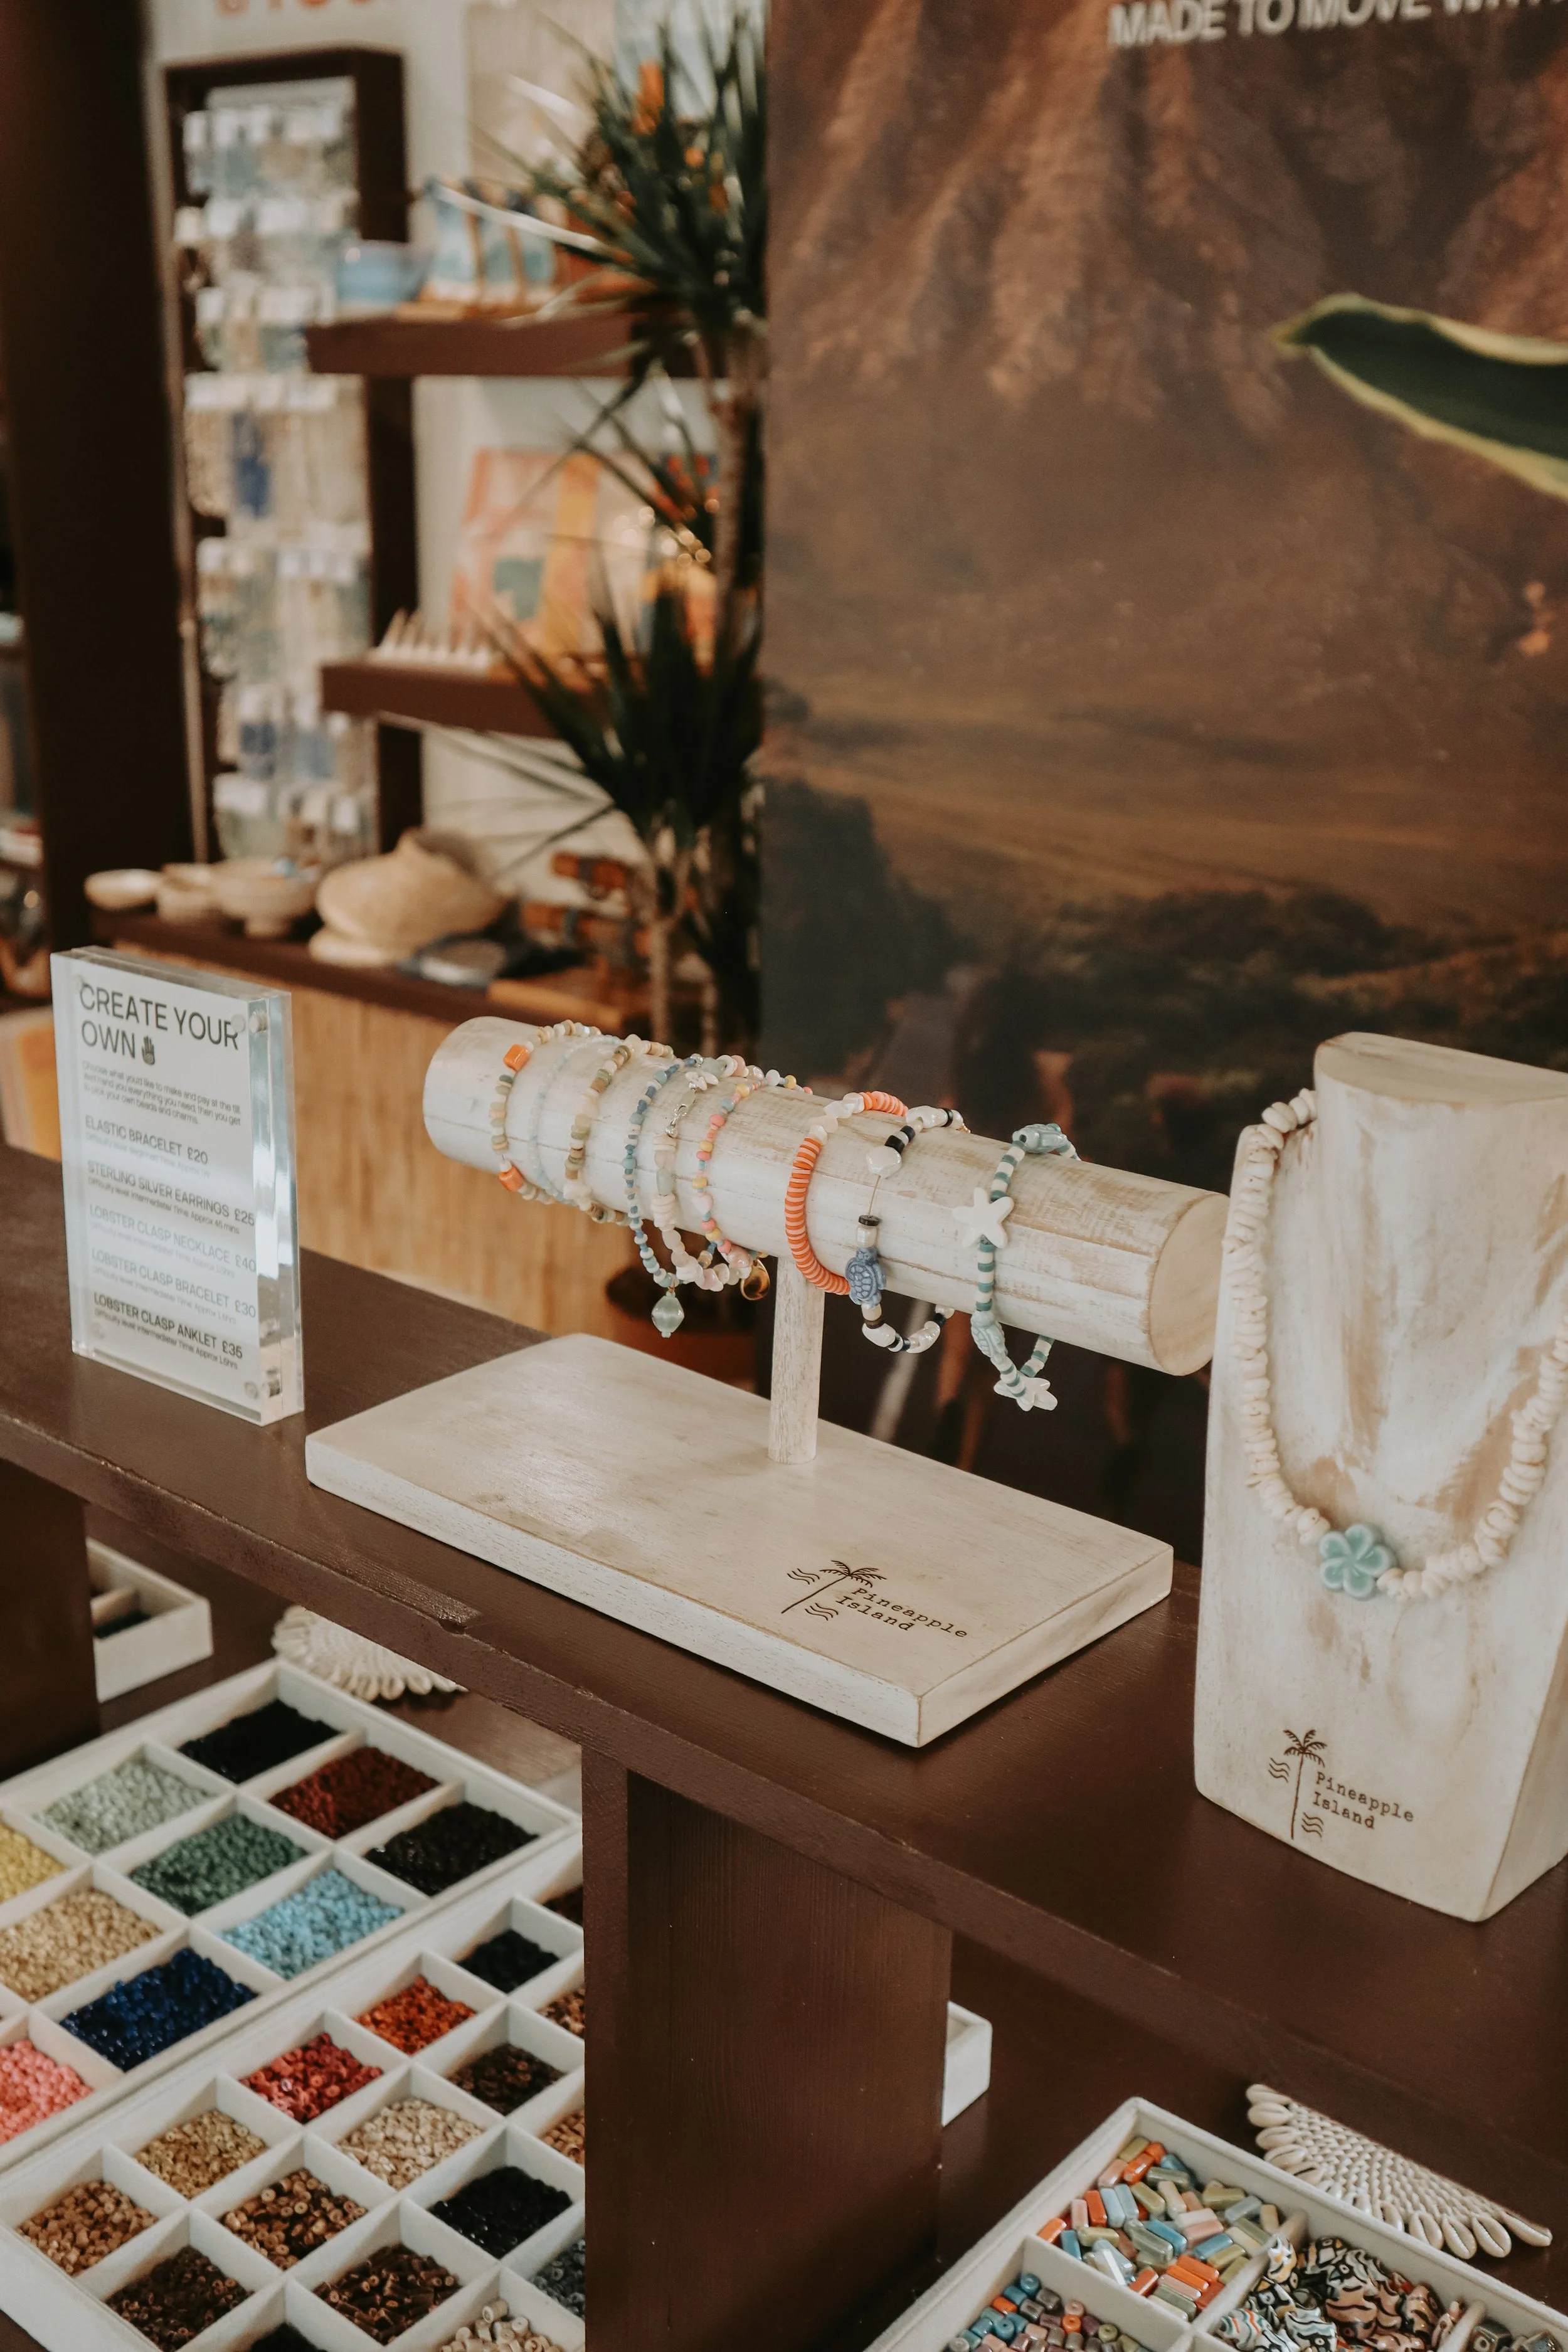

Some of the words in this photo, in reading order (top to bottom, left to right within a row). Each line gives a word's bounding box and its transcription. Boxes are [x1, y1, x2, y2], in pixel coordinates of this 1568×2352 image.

[1108, 0, 1227, 47] MADE
[80, 983, 167, 1030] CREATE
[174, 1008, 238, 1049] YOUR
[82, 1020, 135, 1059] OWN
[159, 1106, 171, 1116] and
[164, 1084, 181, 1096] make
[183, 1091, 196, 1101] and
[198, 1095, 209, 1106] pay
[211, 1098, 217, 1107] at
[220, 1101, 231, 1111] the
[164, 1097, 176, 1108] you
[198, 1106, 213, 1117] then
[215, 1112, 227, 1123] you
[229, 1116, 240, 1127] get
[85, 1115, 126, 1139] ELASTIC
[129, 1129, 182, 1157] BRACELET
[188, 1147, 208, 1165] £20
[88, 1160, 135, 1187] STERLING
[138, 1177, 172, 1199] SILVER
[174, 1189, 229, 1217] EARRINGS
[234, 1209, 253, 1226] £25
[90, 1204, 134, 1231] LOBSTER
[137, 1221, 171, 1243] CLASP
[173, 1234, 230, 1264] NECKLACE
[235, 1254, 256, 1273] £40
[92, 1248, 136, 1274] LOBSTER
[139, 1265, 172, 1288] CLASP
[176, 1279, 230, 1310] BRACELET
[235, 1300, 256, 1319] £30
[94, 1293, 138, 1320] LOBSTER
[141, 1310, 174, 1333] CLASP
[177, 1324, 216, 1349] ANKLET
[222, 1341, 242, 1359] £35
[835, 1596, 916, 1631] Island
[851, 1587, 968, 1638] Pineapple
[1312, 1791, 1375, 1830] Island
[1316, 1771, 1414, 1822] Pineapple
